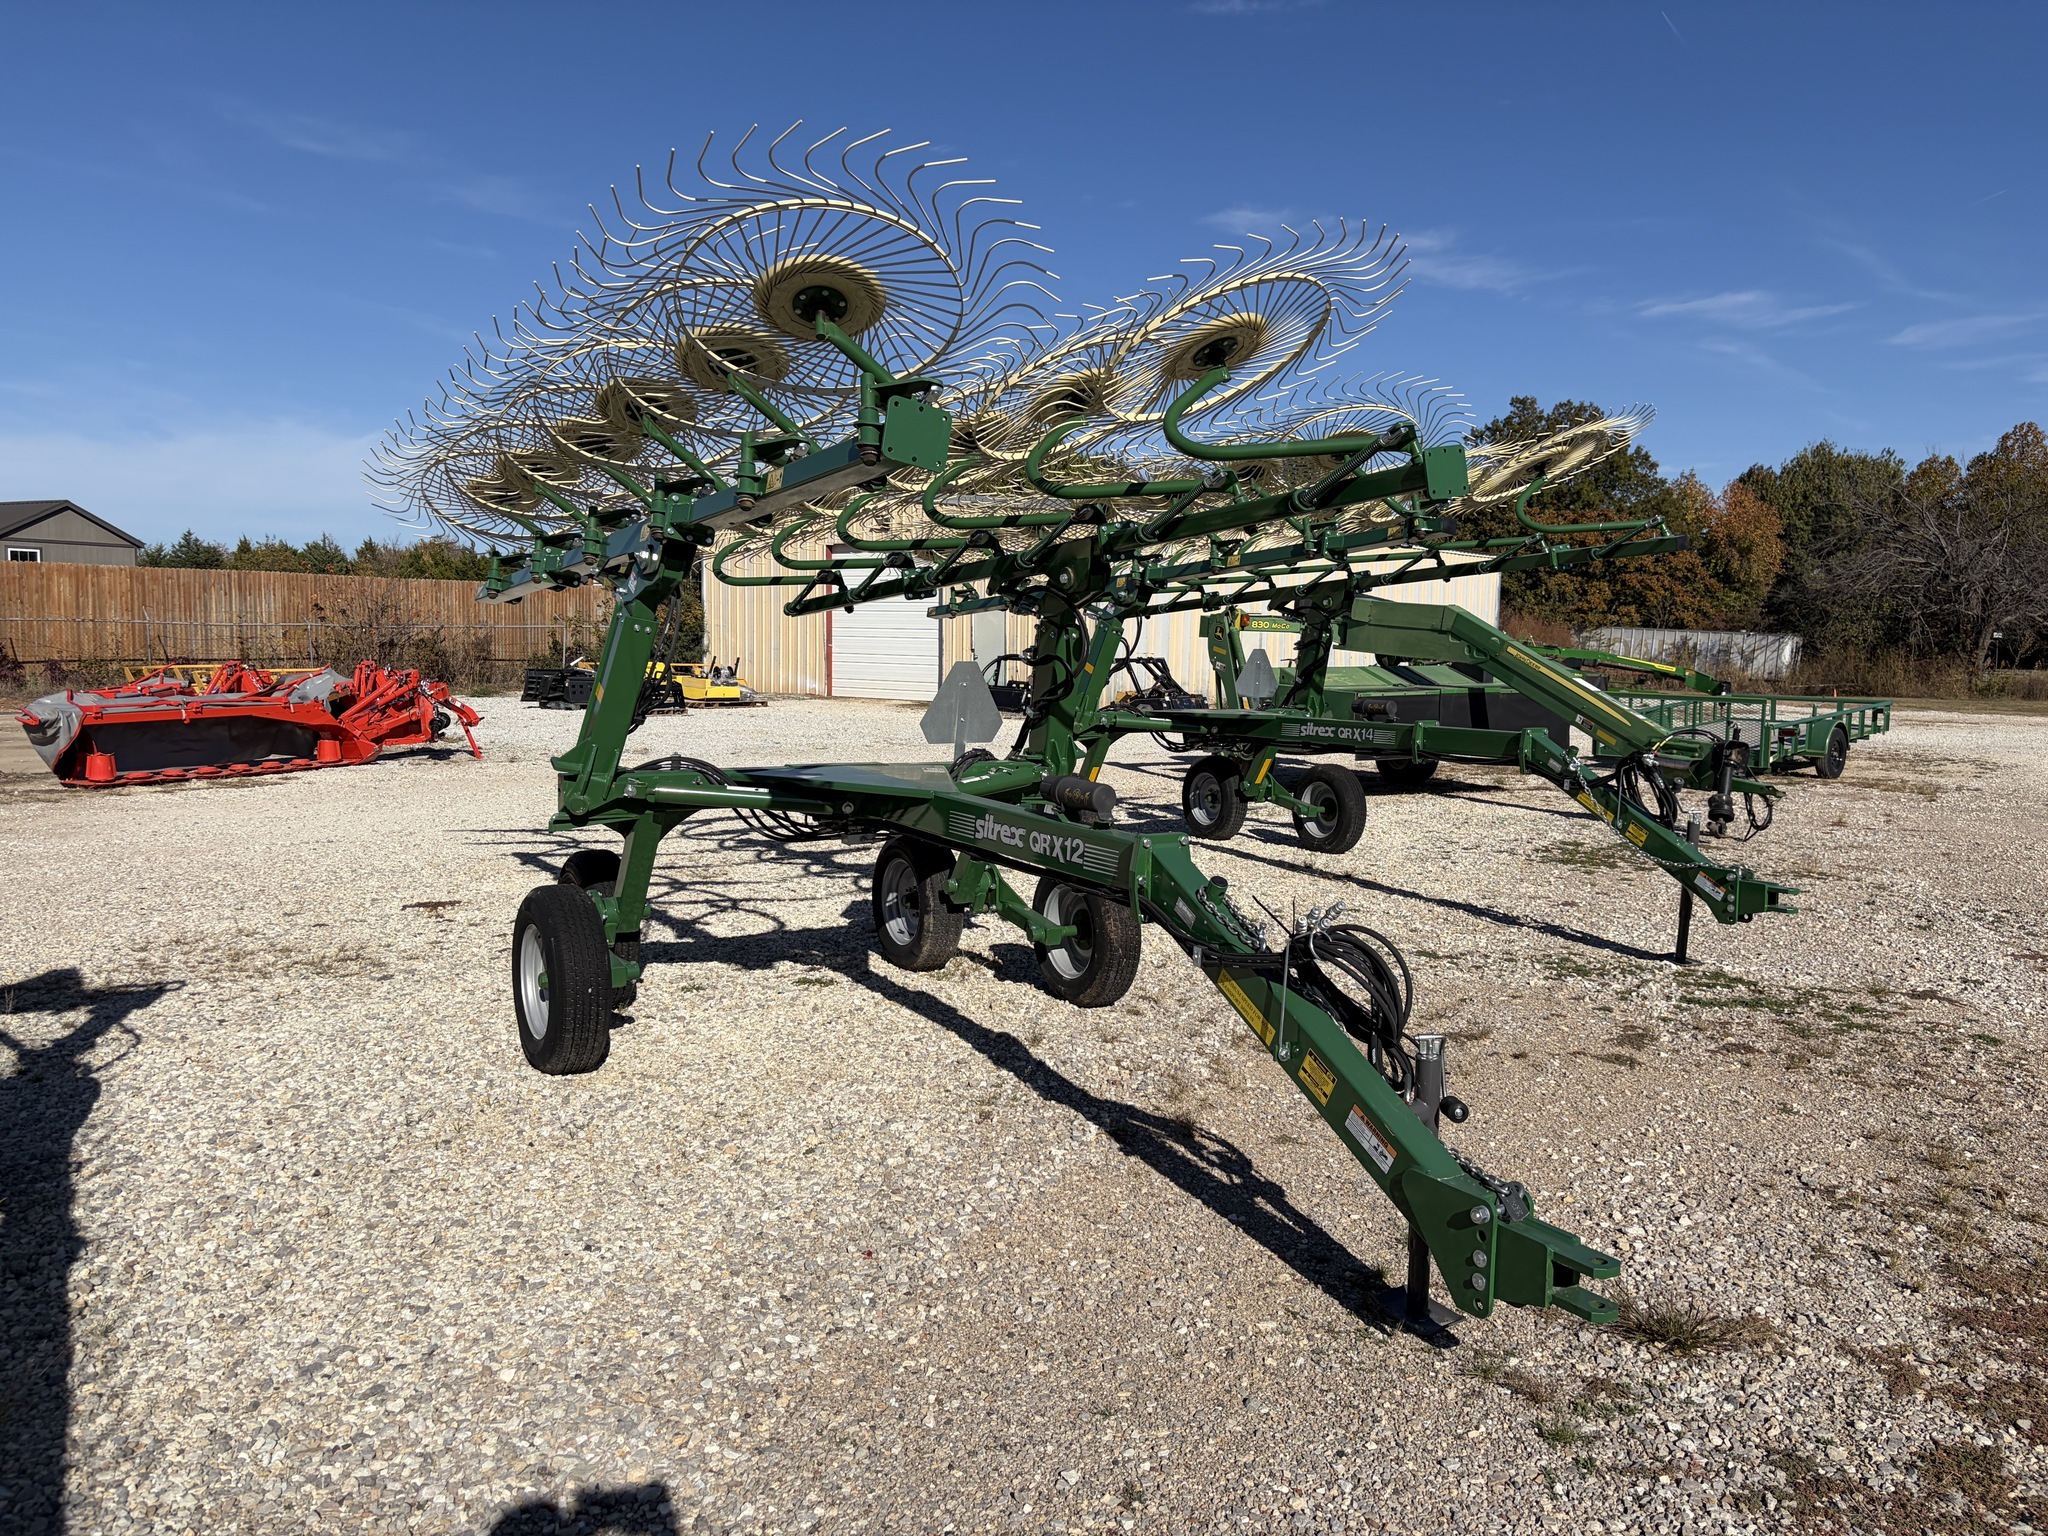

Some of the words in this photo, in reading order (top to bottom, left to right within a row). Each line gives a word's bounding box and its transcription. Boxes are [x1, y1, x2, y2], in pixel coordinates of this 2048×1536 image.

[1251, 620, 1270, 629] 830
[1300, 722, 1336, 738] sitrex
[975, 813, 1026, 848] sitrex
[1364, 1118, 1389, 1149] WARNING
